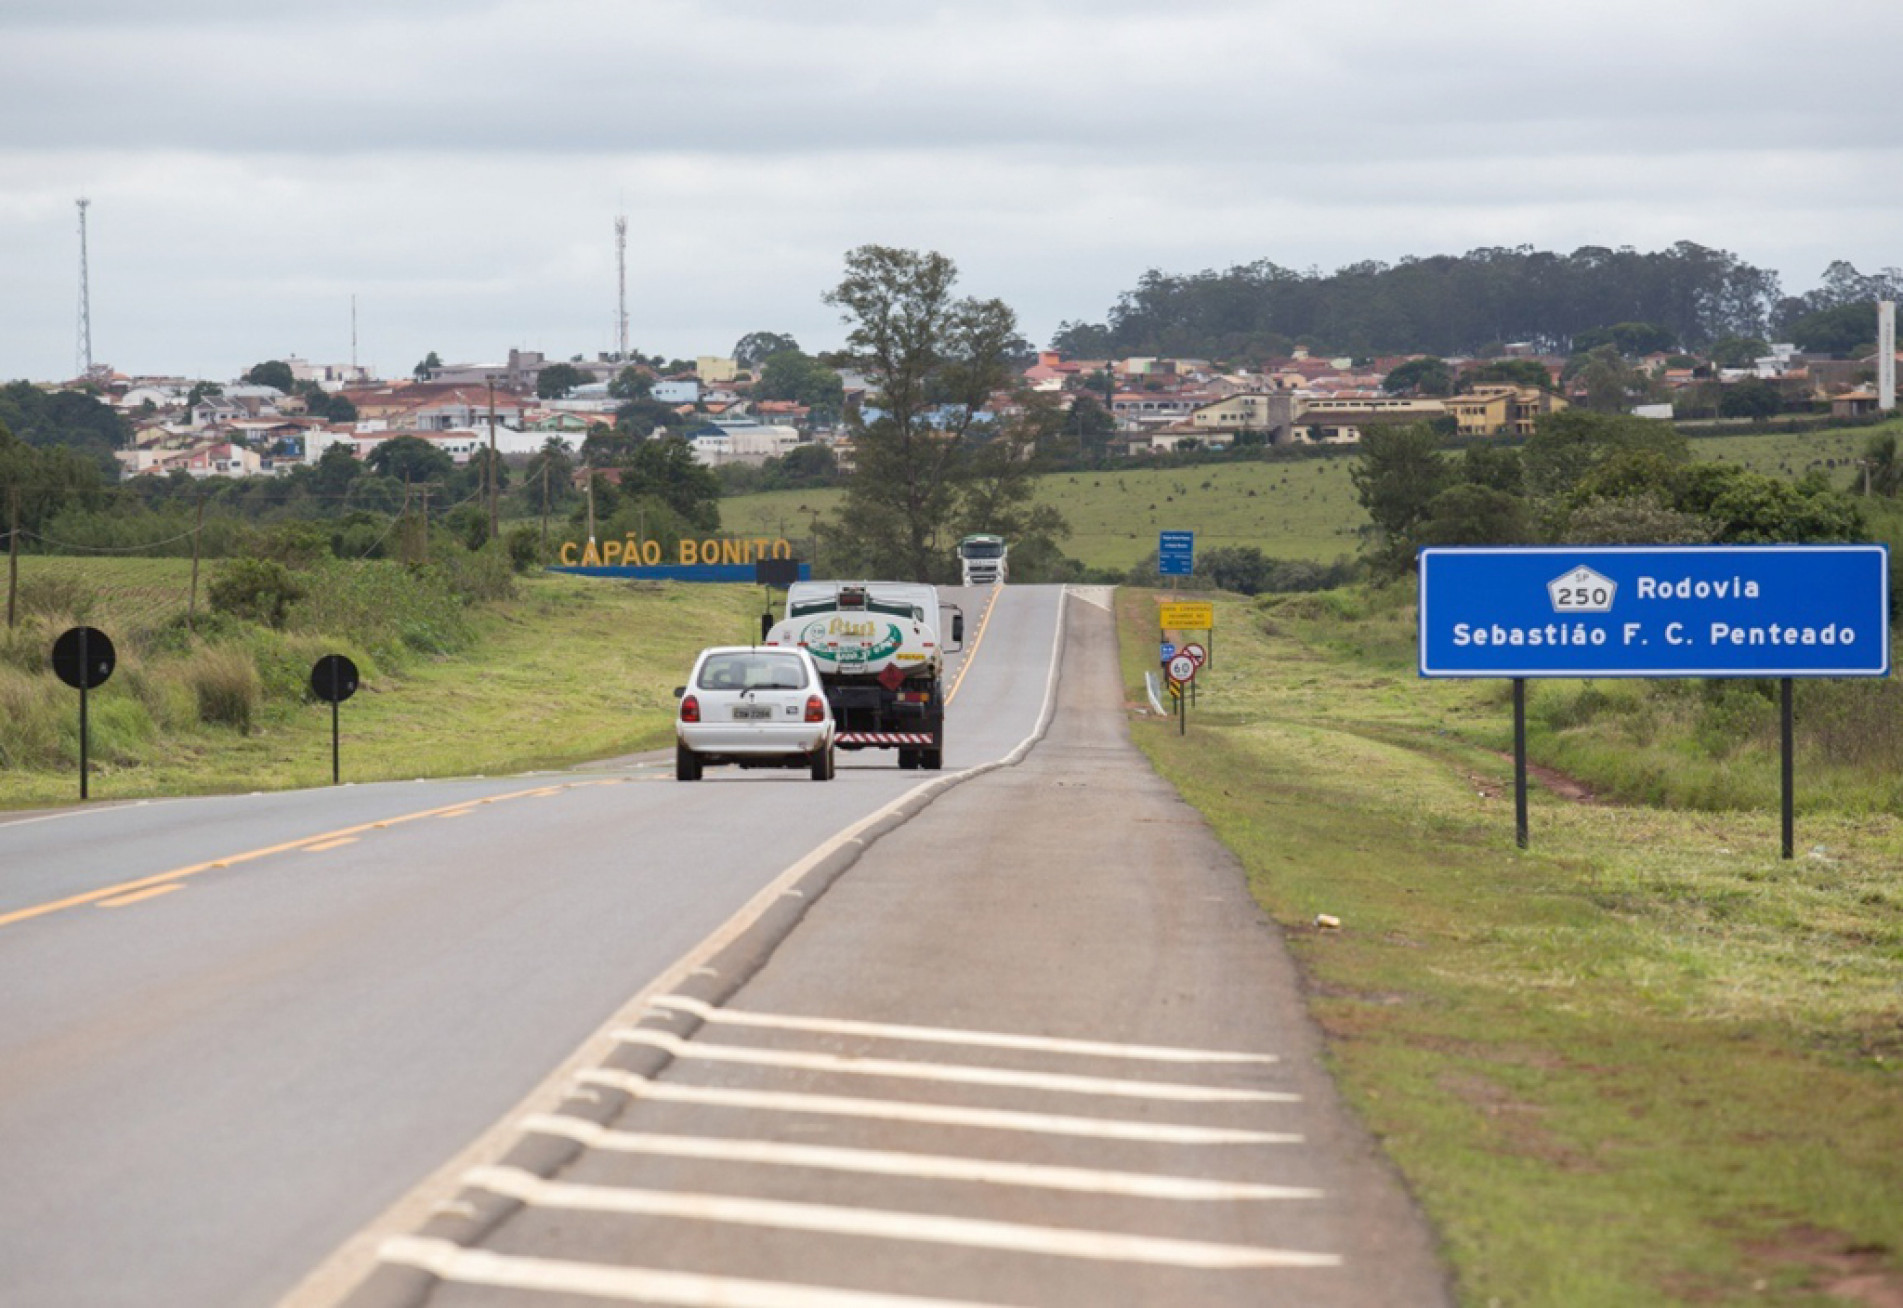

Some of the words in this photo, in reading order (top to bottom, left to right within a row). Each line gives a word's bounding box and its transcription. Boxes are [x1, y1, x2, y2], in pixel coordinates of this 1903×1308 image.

[560, 532, 661, 567] CAPÃO
[679, 538, 791, 566] BONITO
[1575, 573, 1590, 583] SP
[1558, 588, 1607, 605] 250
[1637, 576, 1760, 599] Rodovia
[1623, 623, 1648, 646] F.
[1664, 622, 1693, 646] C.
[1710, 622, 1856, 646] Penteado
[1174, 663, 1190, 674] 60
